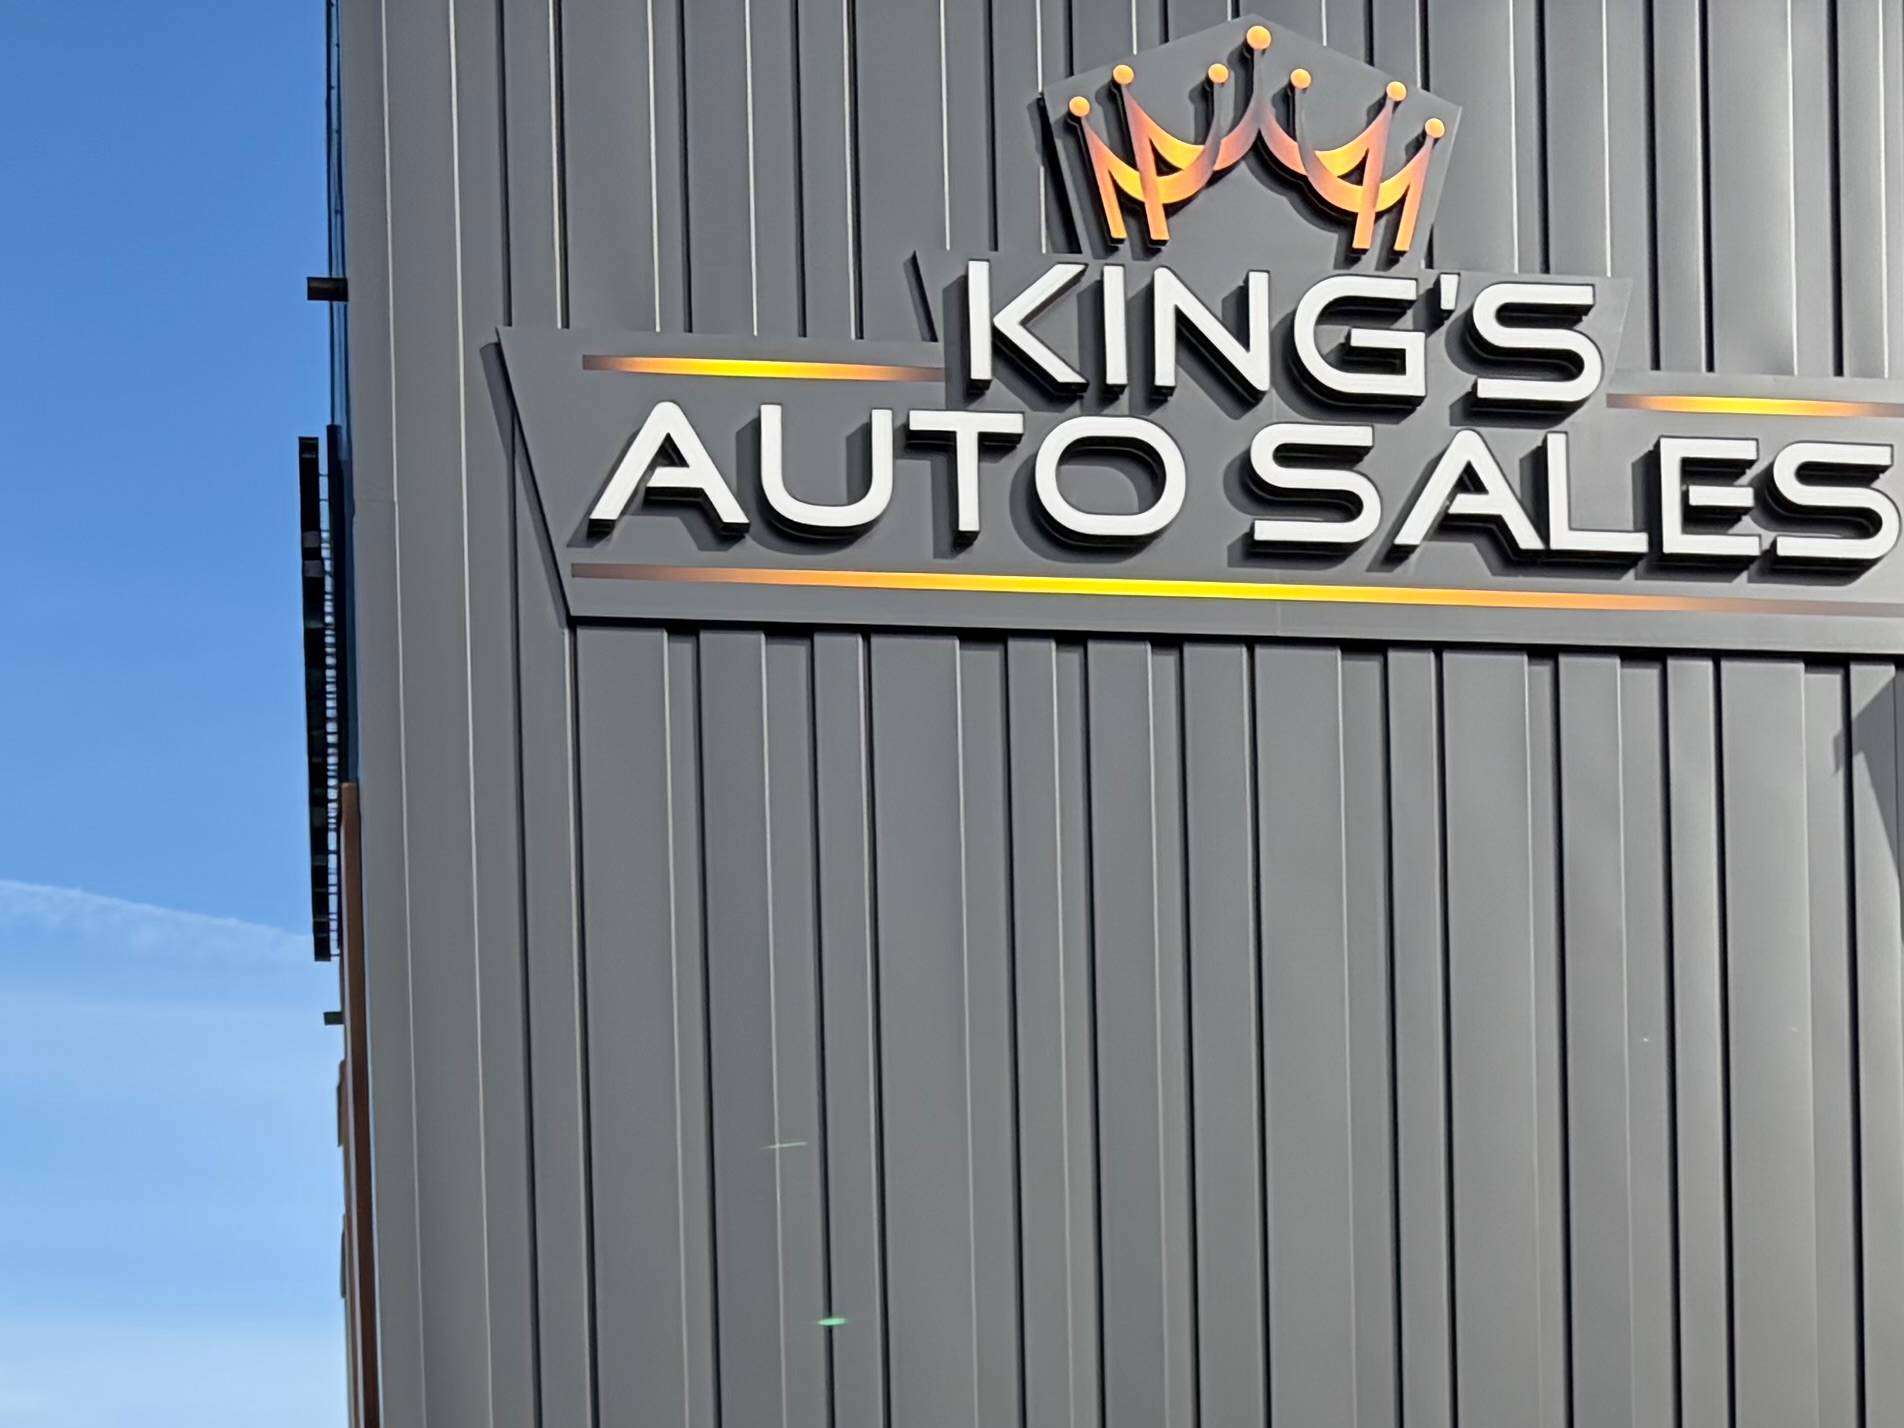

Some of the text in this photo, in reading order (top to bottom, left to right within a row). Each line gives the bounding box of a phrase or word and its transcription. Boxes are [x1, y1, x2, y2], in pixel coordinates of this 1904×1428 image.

[966, 258, 1606, 404] KING'S
[586, 400, 1902, 560] AUTO SALES
